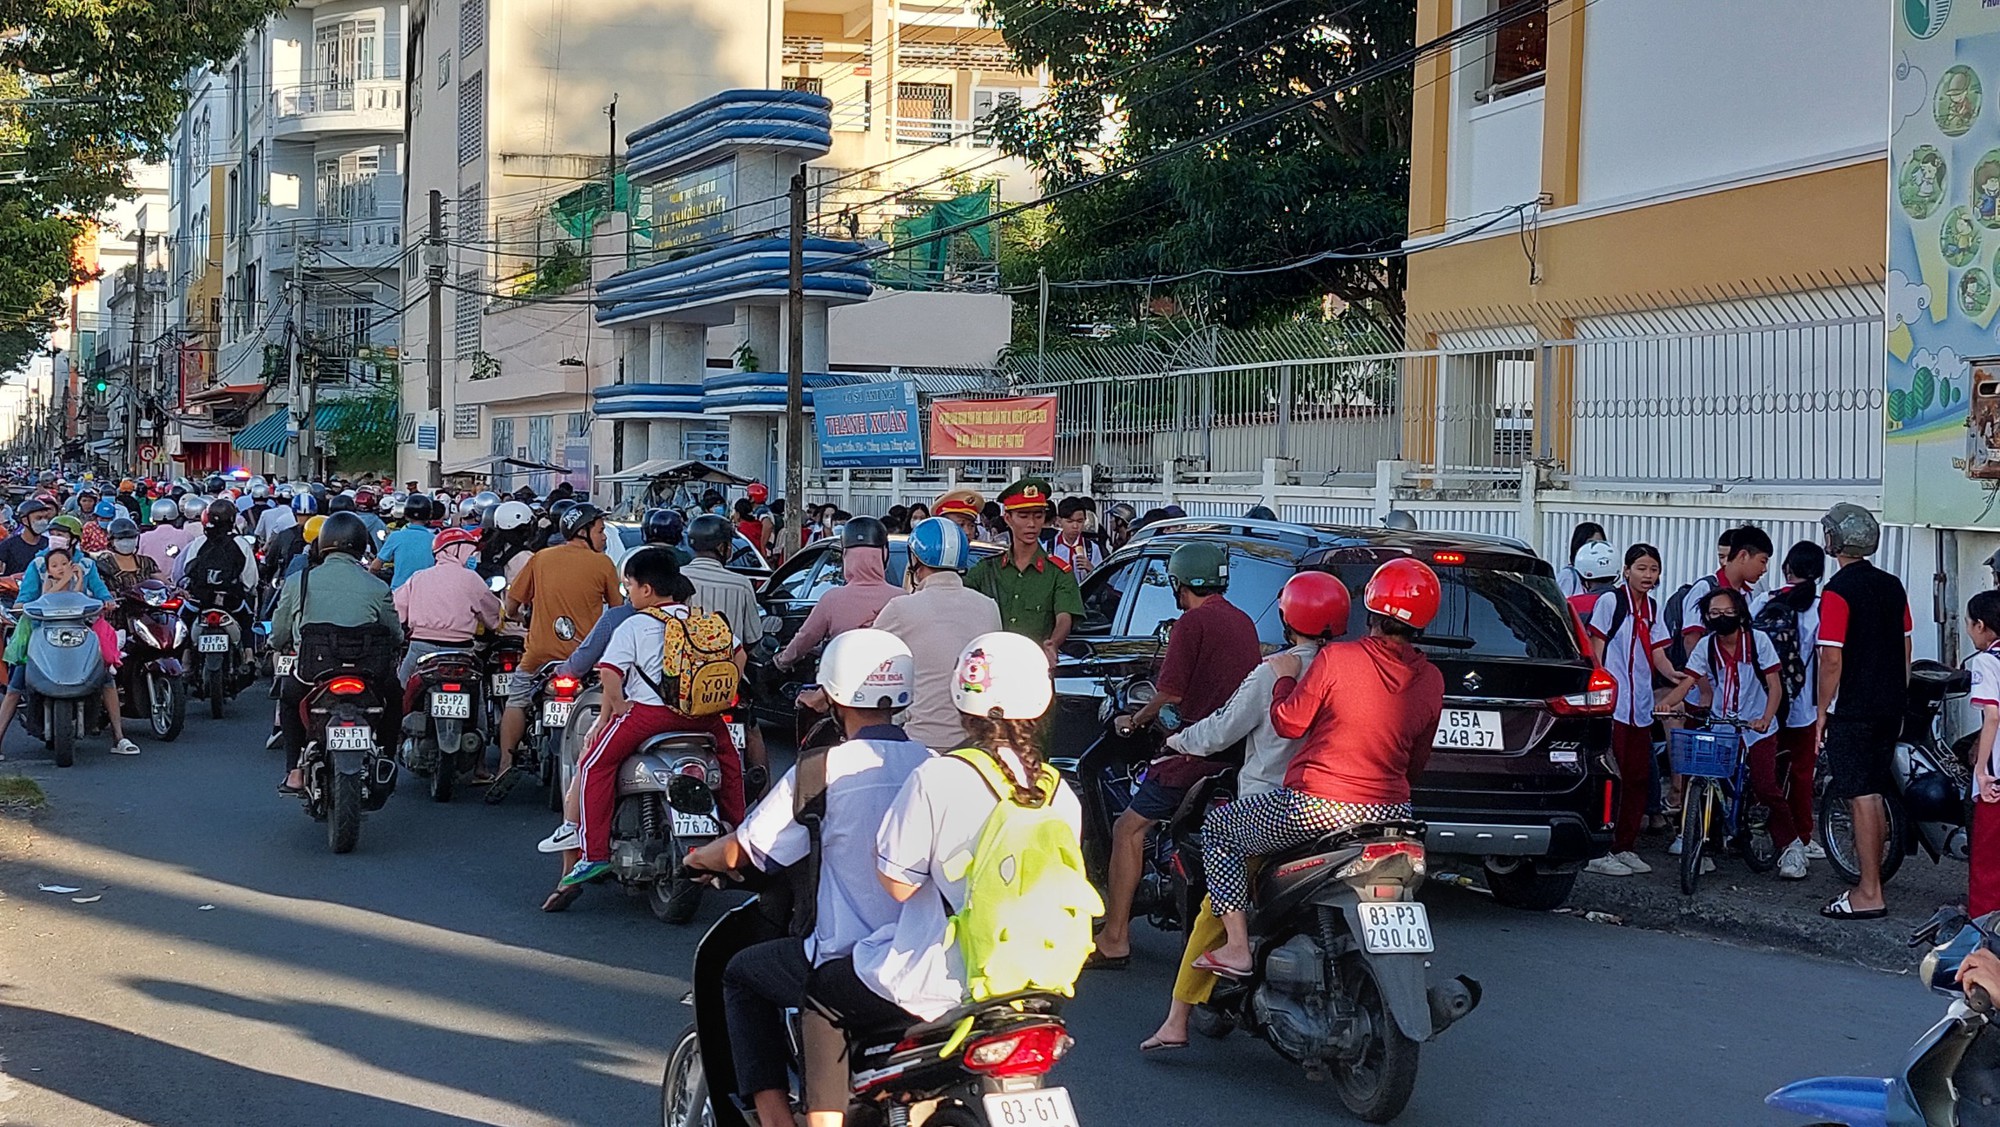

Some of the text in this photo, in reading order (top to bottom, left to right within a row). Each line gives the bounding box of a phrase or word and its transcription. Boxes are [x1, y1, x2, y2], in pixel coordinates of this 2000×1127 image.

[825, 413, 868, 437] THANH
[869, 404, 908, 435] XUÂN
[702, 677, 733, 691] YOU
[437, 694, 464, 705] 83-P2
[701, 690, 731, 704] WIN
[1449, 711, 1481, 728] 65A
[1438, 729, 1495, 748] 348.37
[1369, 906, 1416, 926] 83-P3
[1367, 928, 1428, 949] 290.48
[1001, 1096, 1060, 1125] 83-G1
